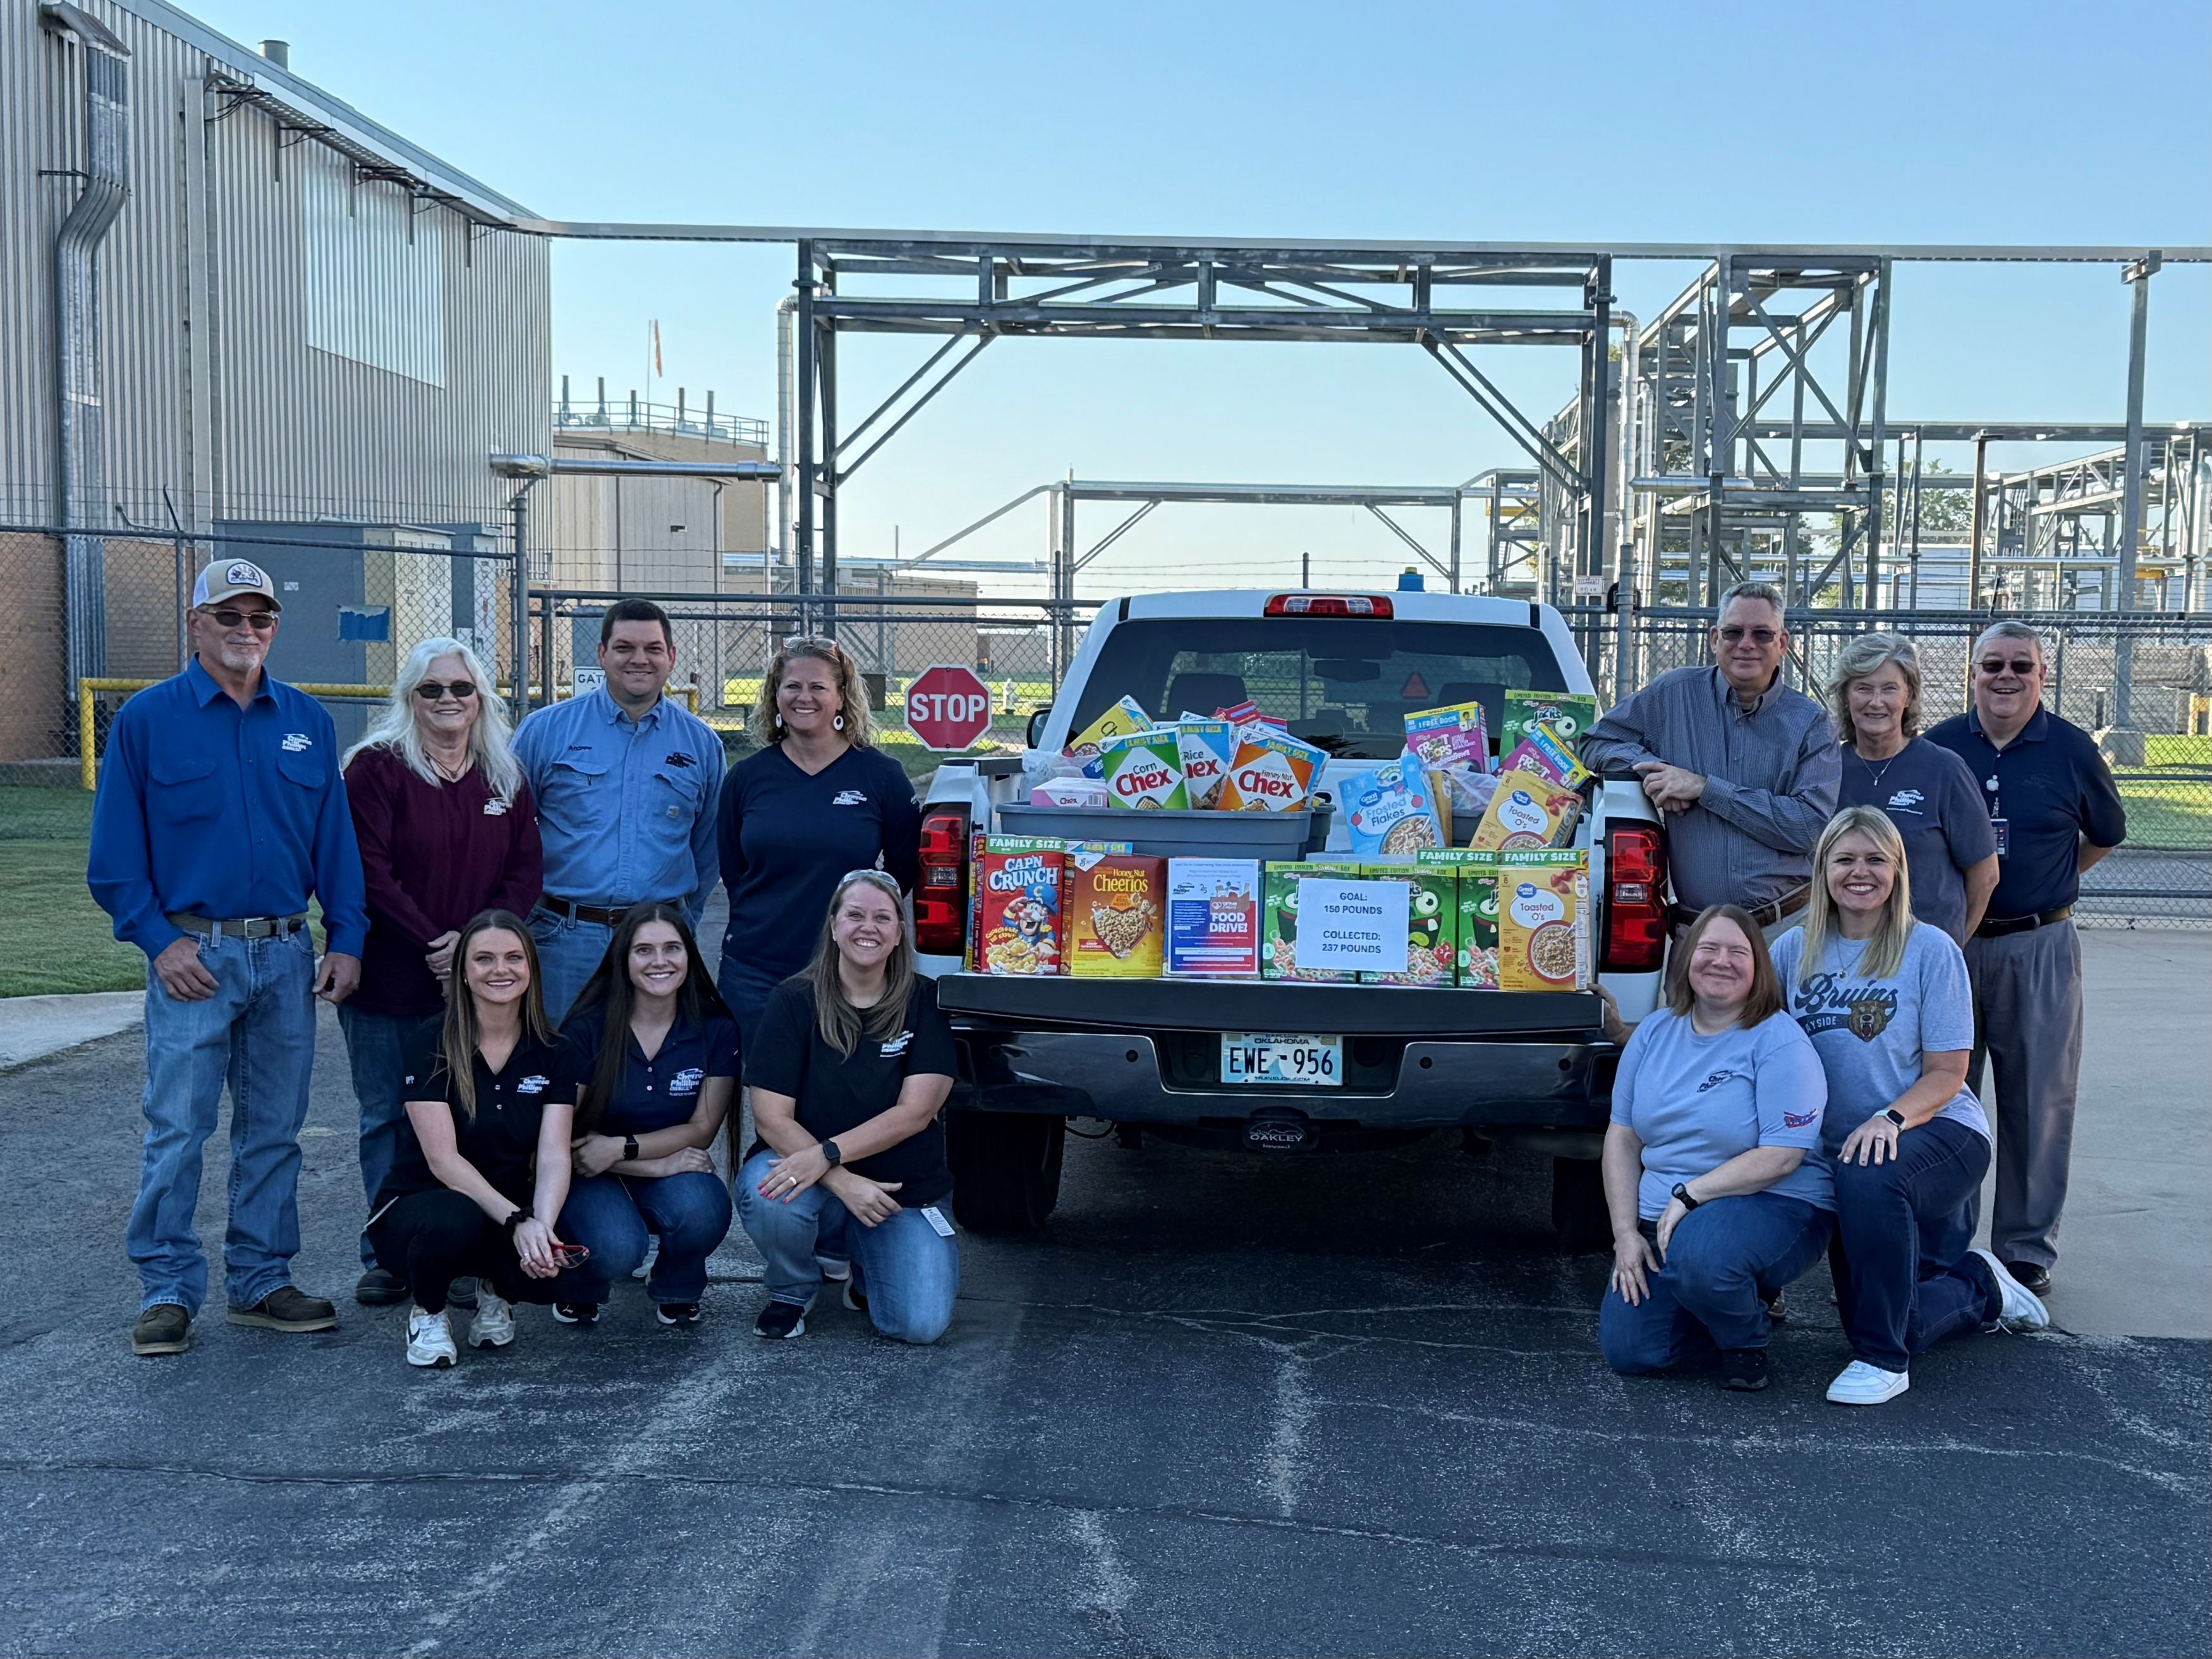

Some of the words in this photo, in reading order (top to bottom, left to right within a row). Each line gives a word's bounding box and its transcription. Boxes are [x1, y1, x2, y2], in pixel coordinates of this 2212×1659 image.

[578, 674, 603, 684] GAT
[911, 693, 986, 722] STOP
[1422, 718, 1439, 728] FREE
[1416, 733, 1450, 757] FROOT
[1184, 750, 1204, 762] Rice
[1421, 744, 1453, 764] LOOPS
[1133, 762, 1157, 775] Corn
[1116, 768, 1174, 796] Chex
[1238, 769, 1295, 799] Chex
[1366, 796, 1407, 819] Frosted
[1371, 808, 1406, 827] Flakes
[1509, 805, 1540, 824] Toasted
[1514, 818, 1528, 829] O's
[990, 838, 1032, 848] FAMILY
[1036, 839, 1062, 849] SIZE
[1420, 851, 1463, 861] FAMILY
[1467, 853, 1493, 861] SIZE
[1505, 853, 1547, 861] FAMILY
[1550, 853, 1577, 861] SIZE
[1005, 854, 1043, 872] CAP'N
[989, 866, 1059, 890] CRUNCH
[1114, 869, 1133, 878] Honey
[1093, 873, 1148, 892] Cheerios
[1339, 892, 1368, 901] GOAL:
[1342, 906, 1383, 915] POUNDS
[1521, 903, 1554, 911] Toasted
[1212, 913, 1246, 923] FOOD
[1531, 913, 1545, 921] O's
[1210, 923, 1248, 933] DRIVE!
[1323, 930, 1381, 940] COLLECTED:
[1322, 944, 1338, 952] 237
[1340, 944, 1382, 954] POUNDS
[1794, 972, 1899, 1014] Bruins
[1804, 1016, 1837, 1033] AYSIDE
[1230, 1047, 1271, 1074] EWE
[1293, 1048, 1334, 1076] 956
